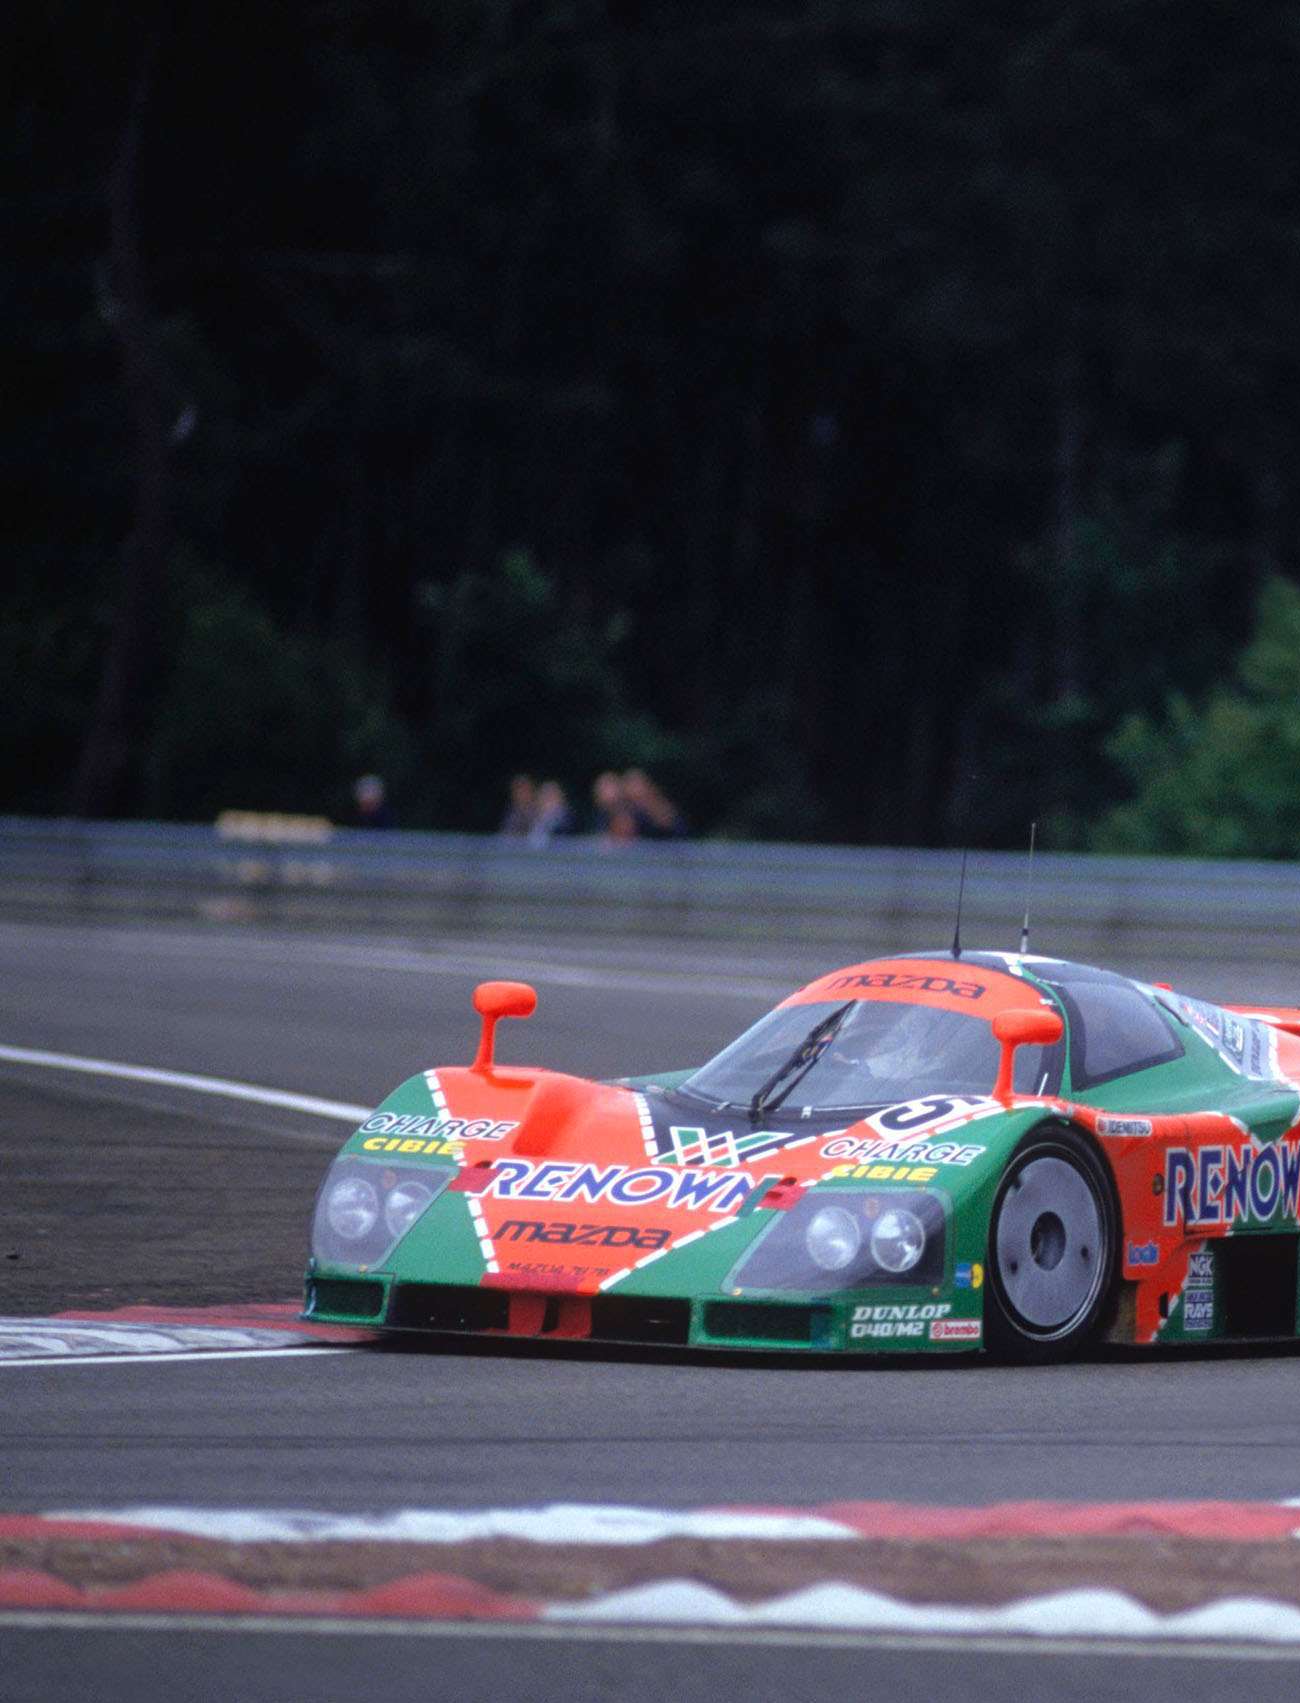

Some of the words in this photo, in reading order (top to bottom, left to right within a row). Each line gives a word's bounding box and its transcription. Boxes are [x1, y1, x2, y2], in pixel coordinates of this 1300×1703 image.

[825, 973, 986, 999] mazda
[359, 1112, 521, 1141] CHARGE
[820, 1137, 986, 1166] CHARGE
[492, 1219, 672, 1250] mazda
[1189, 1254, 1214, 1277] NGK
[851, 1303, 952, 1321] DUNLOP
